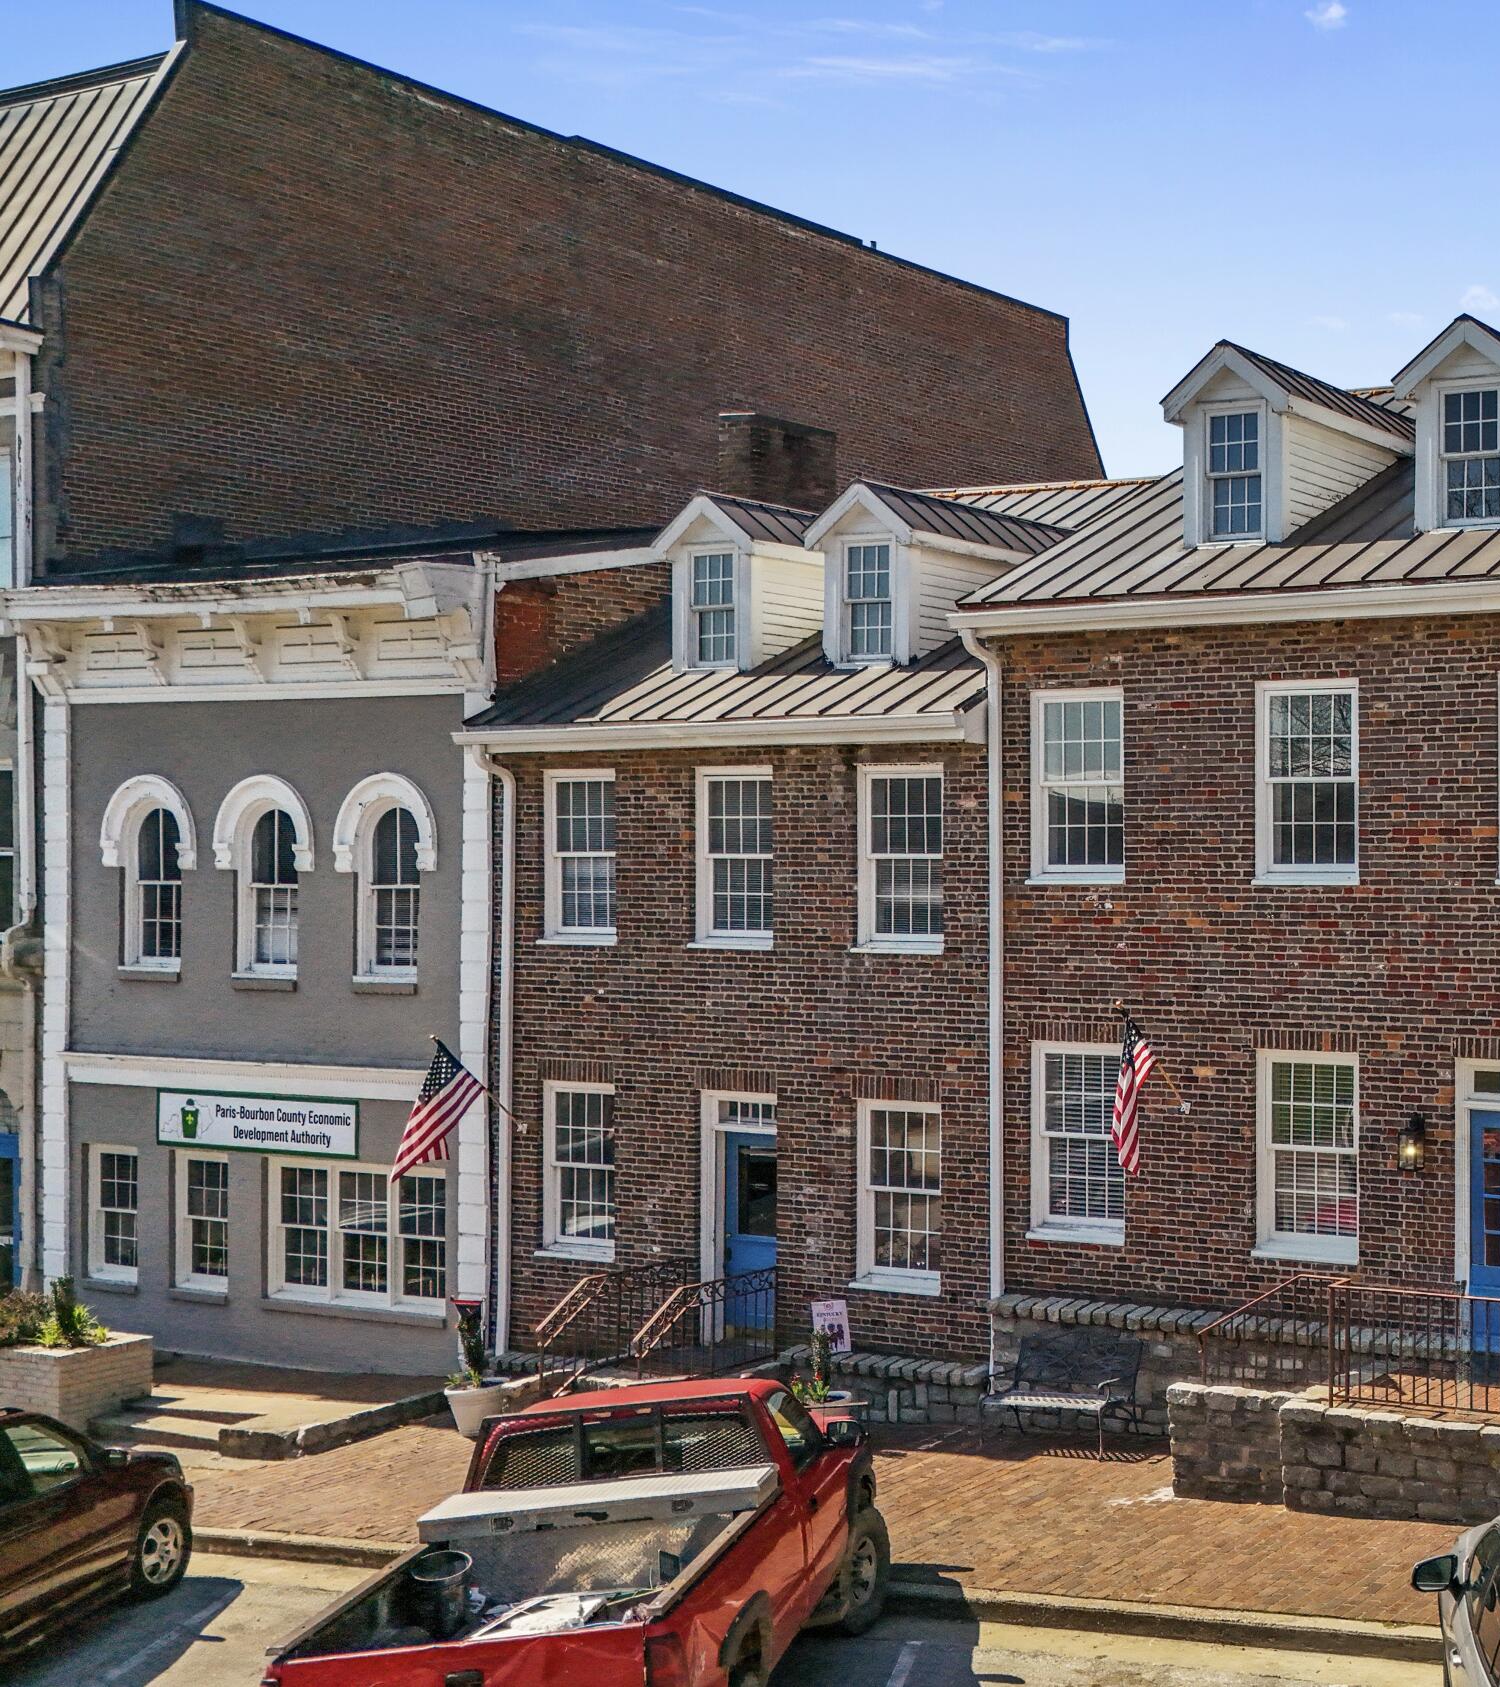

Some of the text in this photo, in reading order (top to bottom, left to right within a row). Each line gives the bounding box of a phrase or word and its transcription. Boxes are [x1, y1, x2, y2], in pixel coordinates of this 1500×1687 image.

[215, 1104, 351, 1127] Paris-Bourbon County Economic
[233, 1125, 331, 1148] Development Authority
